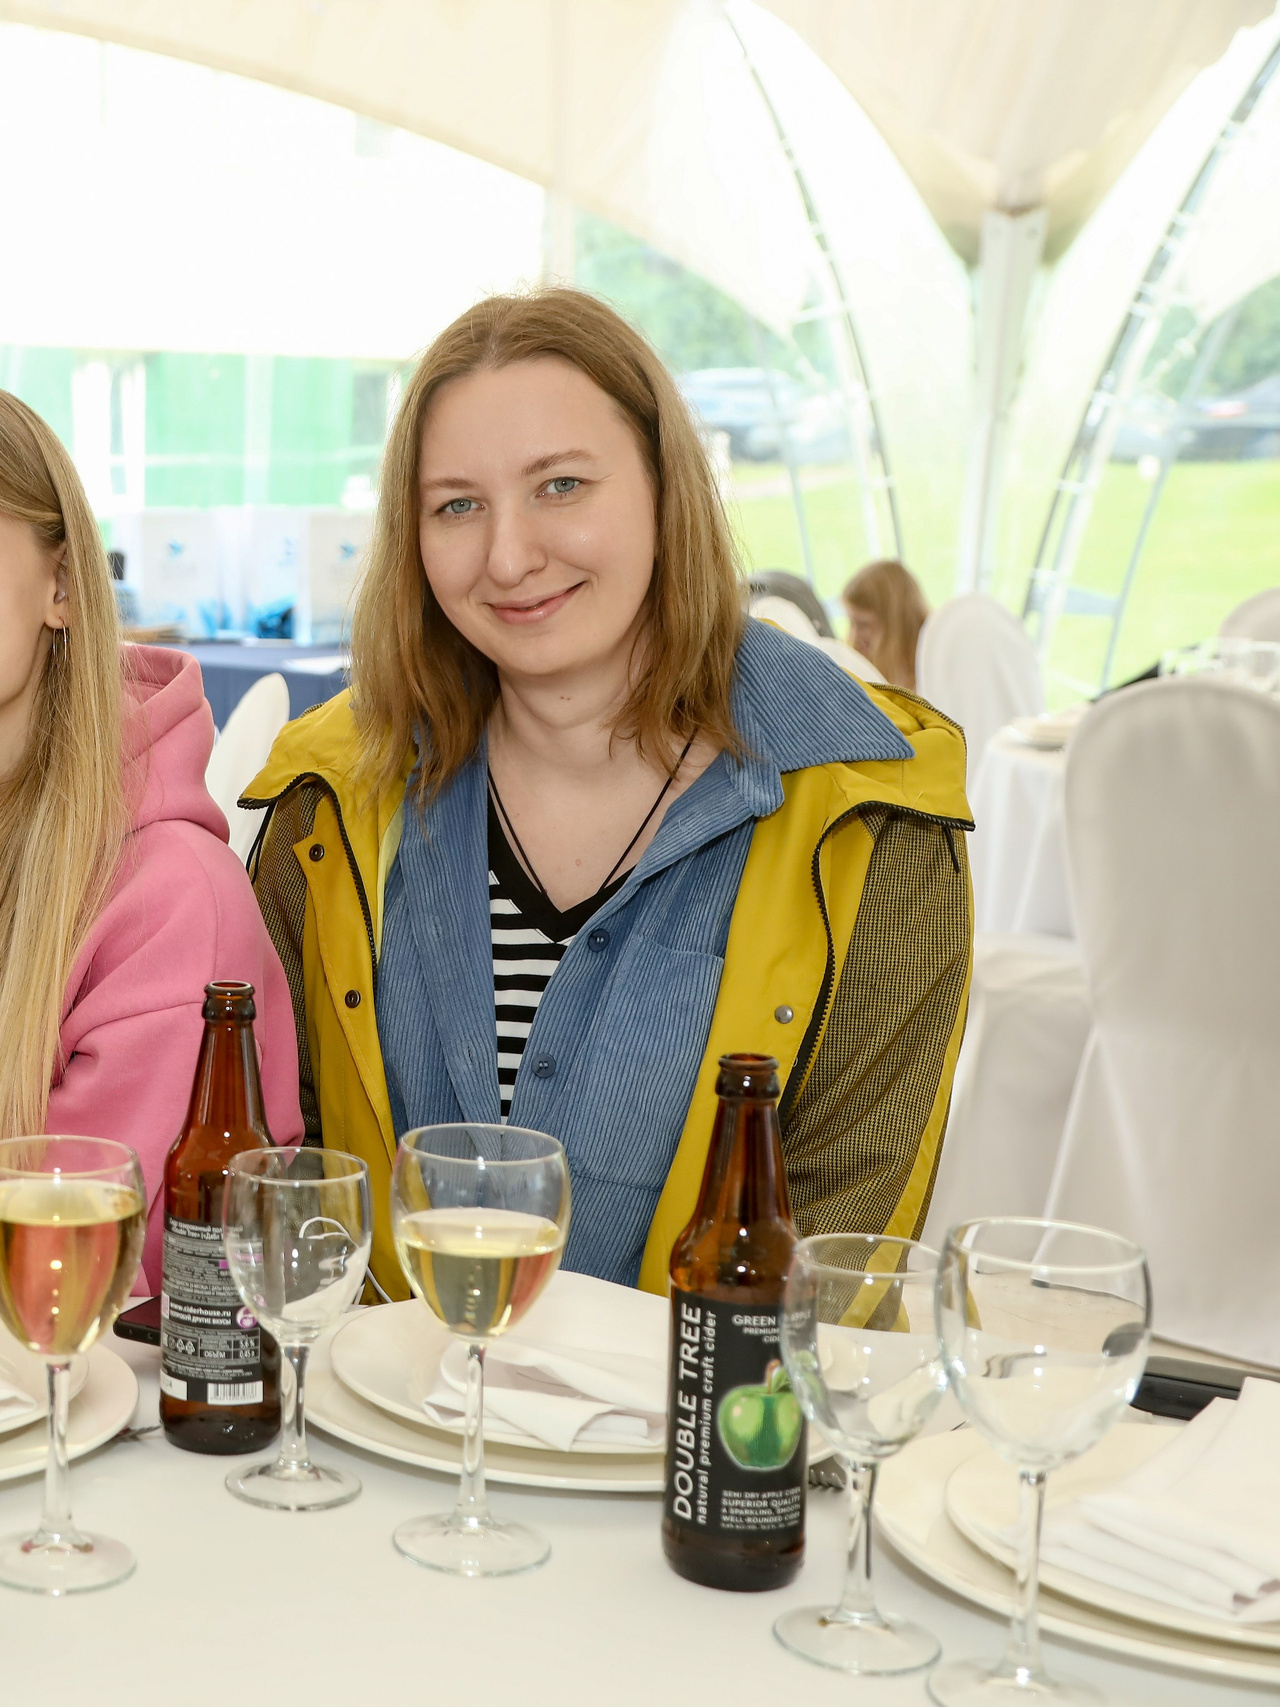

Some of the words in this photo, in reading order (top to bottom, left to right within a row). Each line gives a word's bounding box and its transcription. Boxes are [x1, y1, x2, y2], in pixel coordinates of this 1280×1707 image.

[170, 1302, 232, 1317] www.ciderhouse.ru
[192, 1315, 212, 1324] ДРУГИЕ
[212, 1318, 232, 1326] ВКУСЫ
[732, 1314, 776, 1326] GREEN
[702, 1310, 717, 1352] cider
[743, 1327, 780, 1335] PREMIUM
[678, 1302, 701, 1380] TREE
[700, 1356, 715, 1395] craft
[698, 1398, 713, 1468] premium
[673, 1389, 697, 1521] DOUBLE
[696, 1468, 709, 1526] natural
[722, 1490, 742, 1498] SEMI
[761, 1490, 783, 1499] APPLE
[784, 1486, 800, 1497] CIDER
[721, 1498, 769, 1508] SUPERIOR
[771, 1495, 800, 1507] QUALITY
[776, 1503, 800, 1514] SMOOTH
[784, 1511, 800, 1520] CIDER
